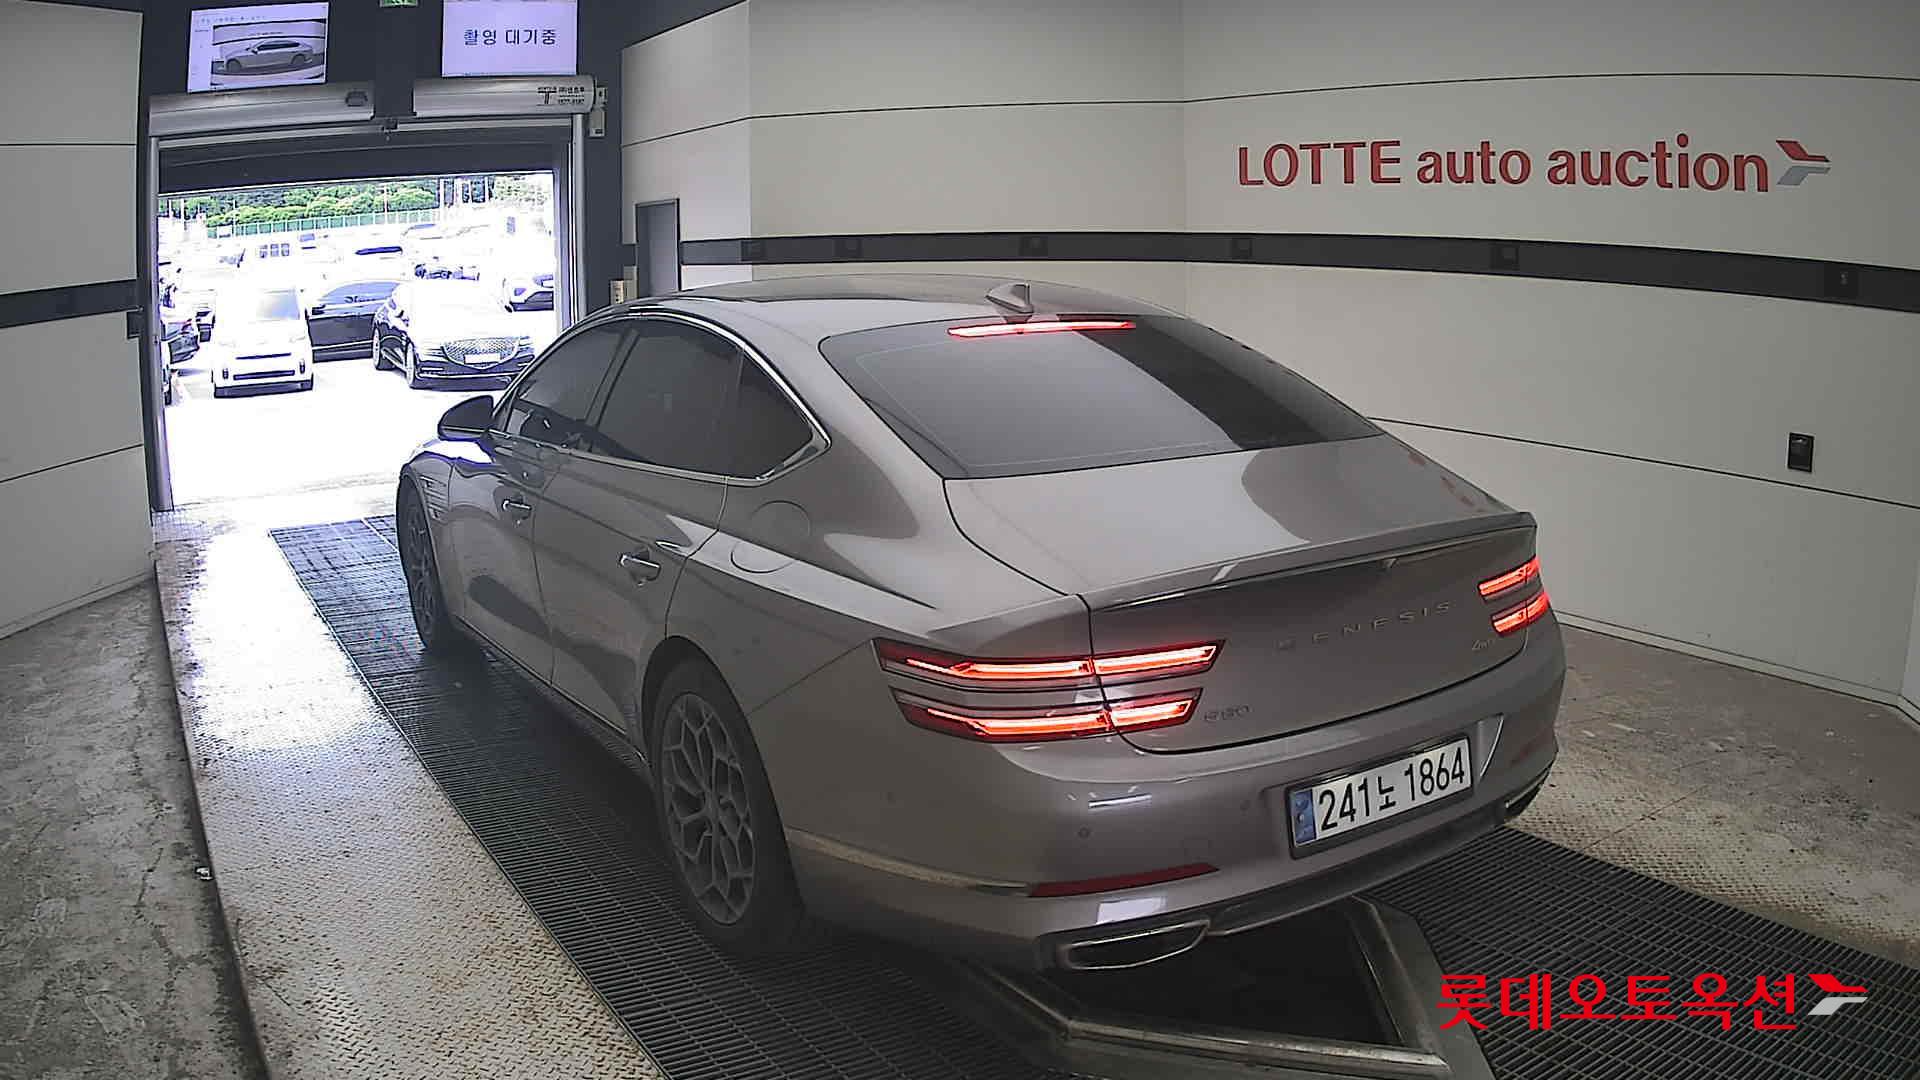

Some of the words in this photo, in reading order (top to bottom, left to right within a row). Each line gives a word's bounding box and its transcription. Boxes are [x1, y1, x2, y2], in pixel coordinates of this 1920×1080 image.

[464, 29, 497, 46] 촬영
[505, 29, 557, 45] 대기중
[1239, 140, 1401, 186] LOTTE
[1417, 141, 1532, 184] auto
[1547, 133, 1769, 192] auction
[1319, 776, 1397, 831] 241노
[1404, 747, 1465, 801] 1864
